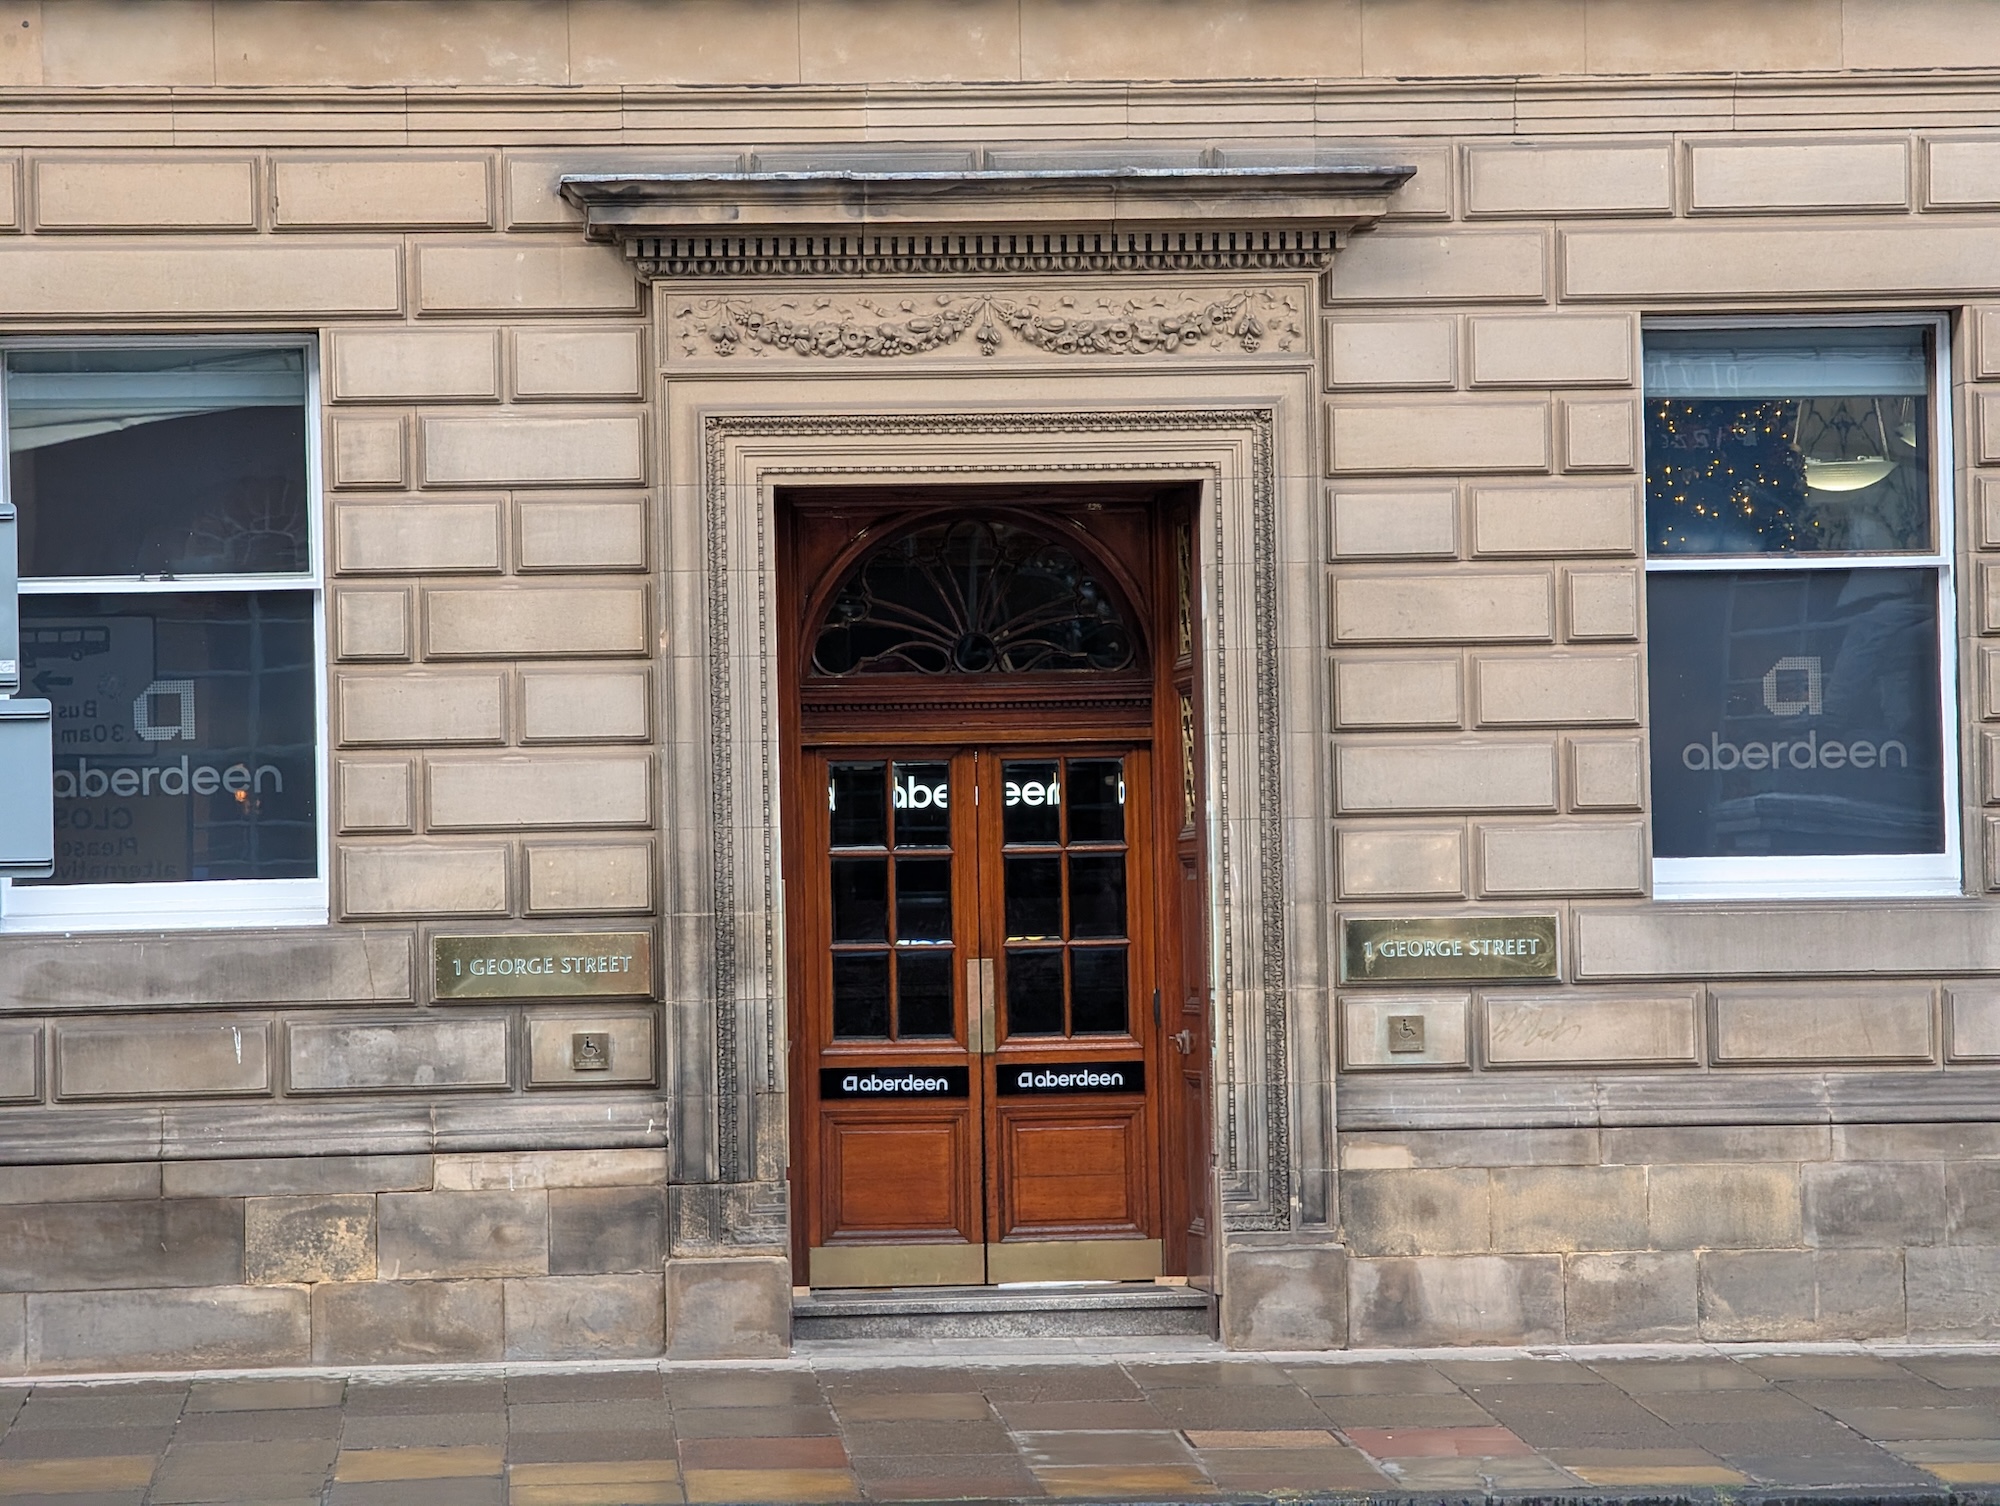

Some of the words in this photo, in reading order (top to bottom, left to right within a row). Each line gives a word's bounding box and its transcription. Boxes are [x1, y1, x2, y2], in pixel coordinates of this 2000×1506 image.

[1682, 730, 1908, 771] aberdeen
[53, 755, 282, 798] aberdeen
[1363, 941, 1373, 958] 1
[1380, 940, 1463, 958] GEORGE
[1469, 938, 1539, 957] STREET
[452, 958, 461, 976] 1
[469, 957, 554, 976] GEORGE
[560, 955, 633, 974] STREET
[859, 1074, 949, 1092] aberdeen
[1034, 1069, 1124, 1088] aberdeen
